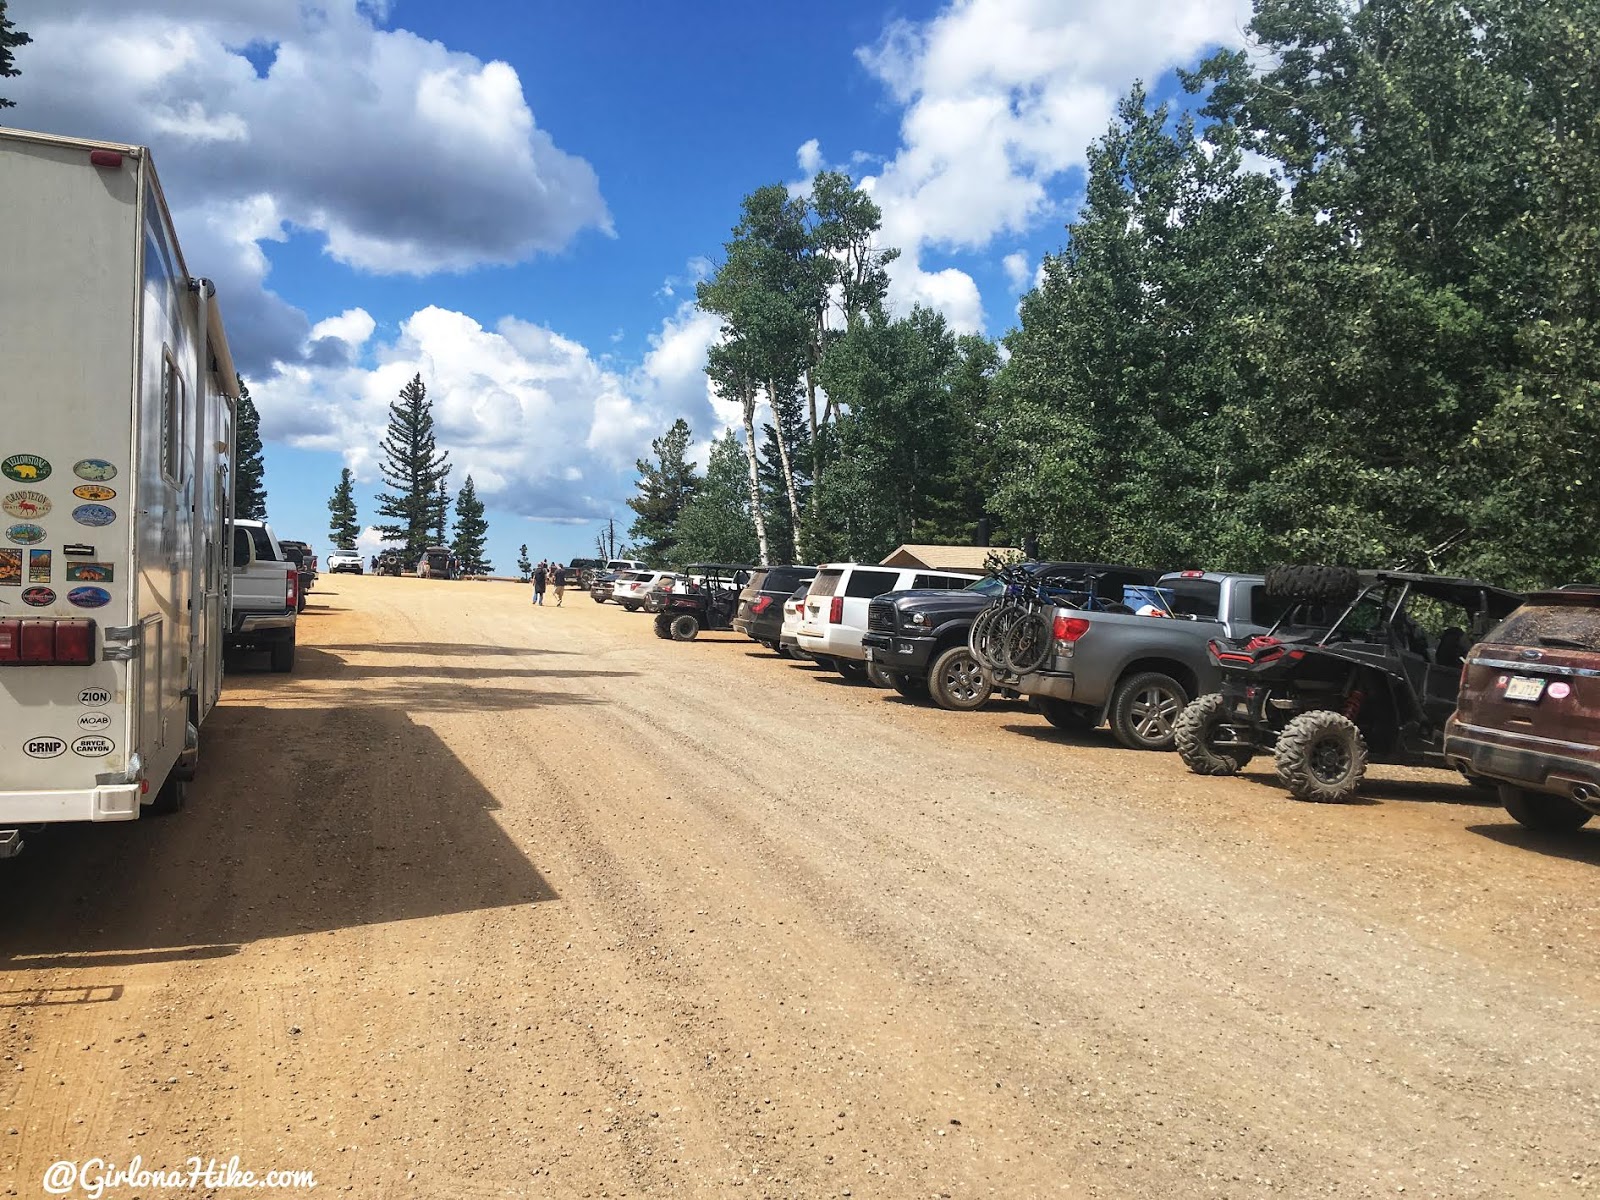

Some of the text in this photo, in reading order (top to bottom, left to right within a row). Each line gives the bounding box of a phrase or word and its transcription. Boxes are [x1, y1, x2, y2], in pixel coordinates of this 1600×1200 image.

[6, 455, 47, 469] YELLOWSTONE
[5, 490, 49, 504] GRAND TETON
[81, 692, 107, 702] ZION
[79, 717, 109, 725] MOAB
[28, 742, 62, 753] CRNP
